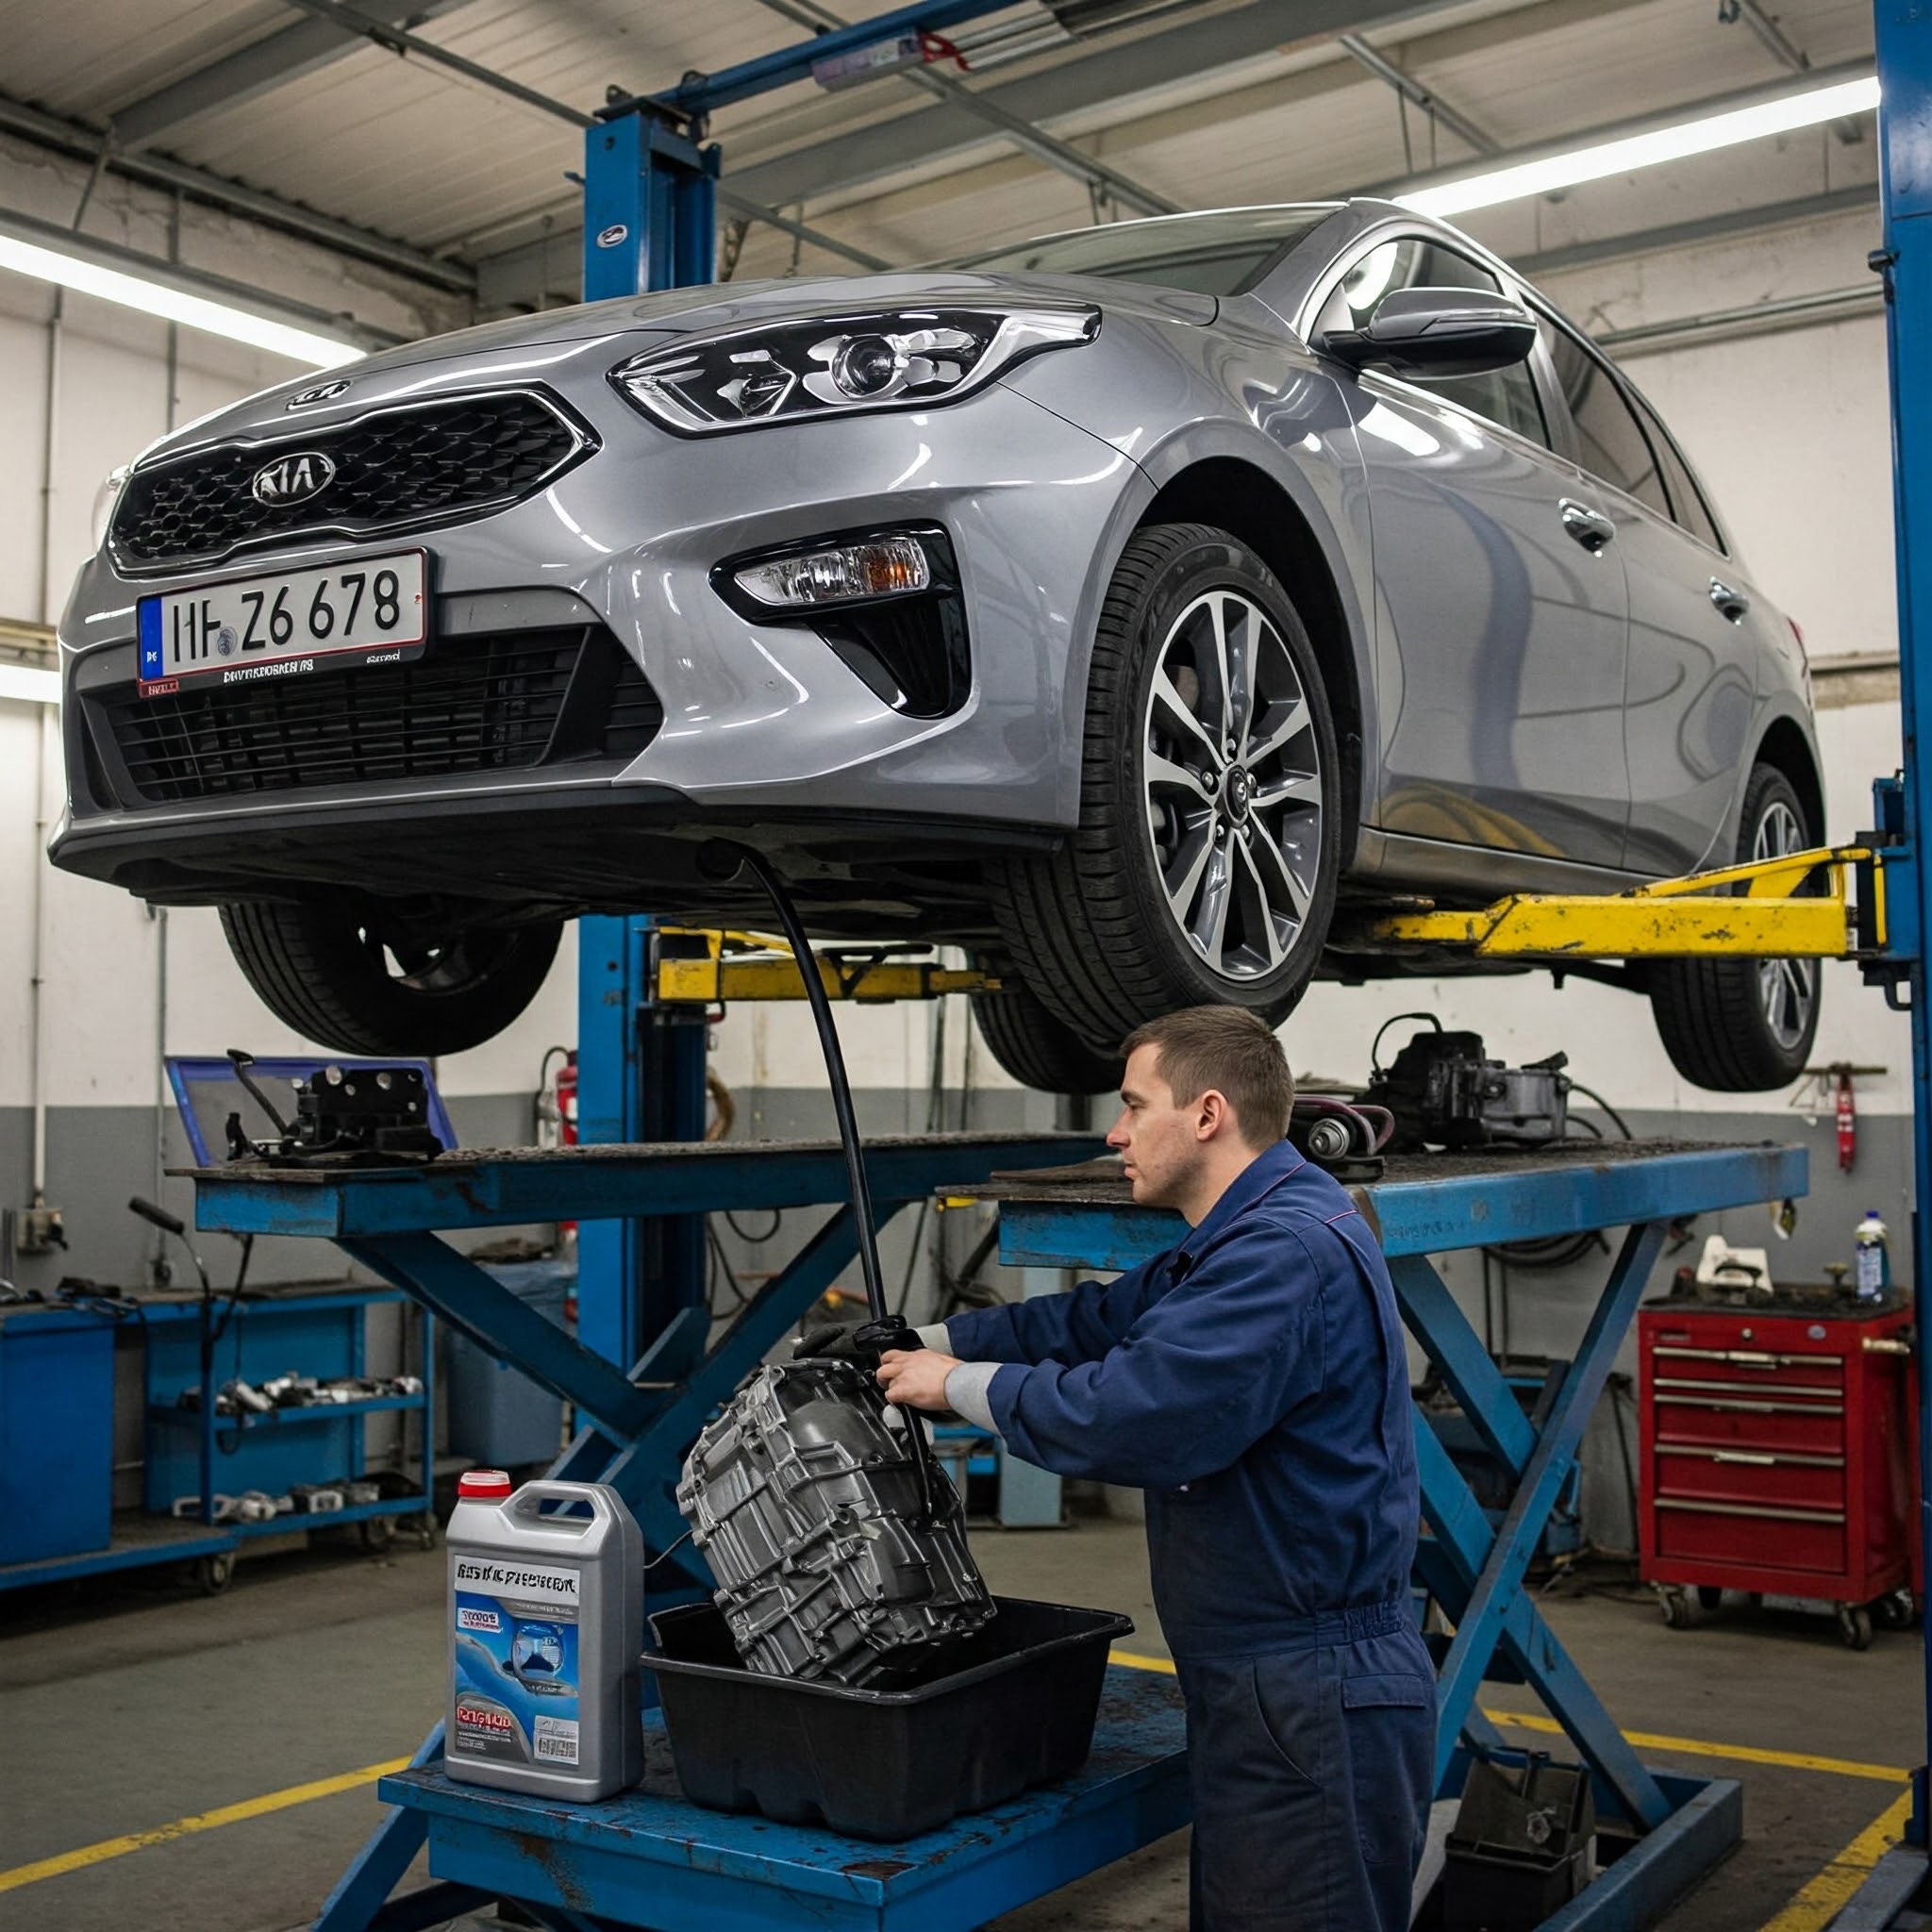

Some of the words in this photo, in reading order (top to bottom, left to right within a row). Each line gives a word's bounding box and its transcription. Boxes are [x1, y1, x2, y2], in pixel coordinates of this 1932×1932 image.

[255, 457, 318, 500] KIA
[242, 584, 294, 650] Z6
[308, 569, 400, 640] 678
